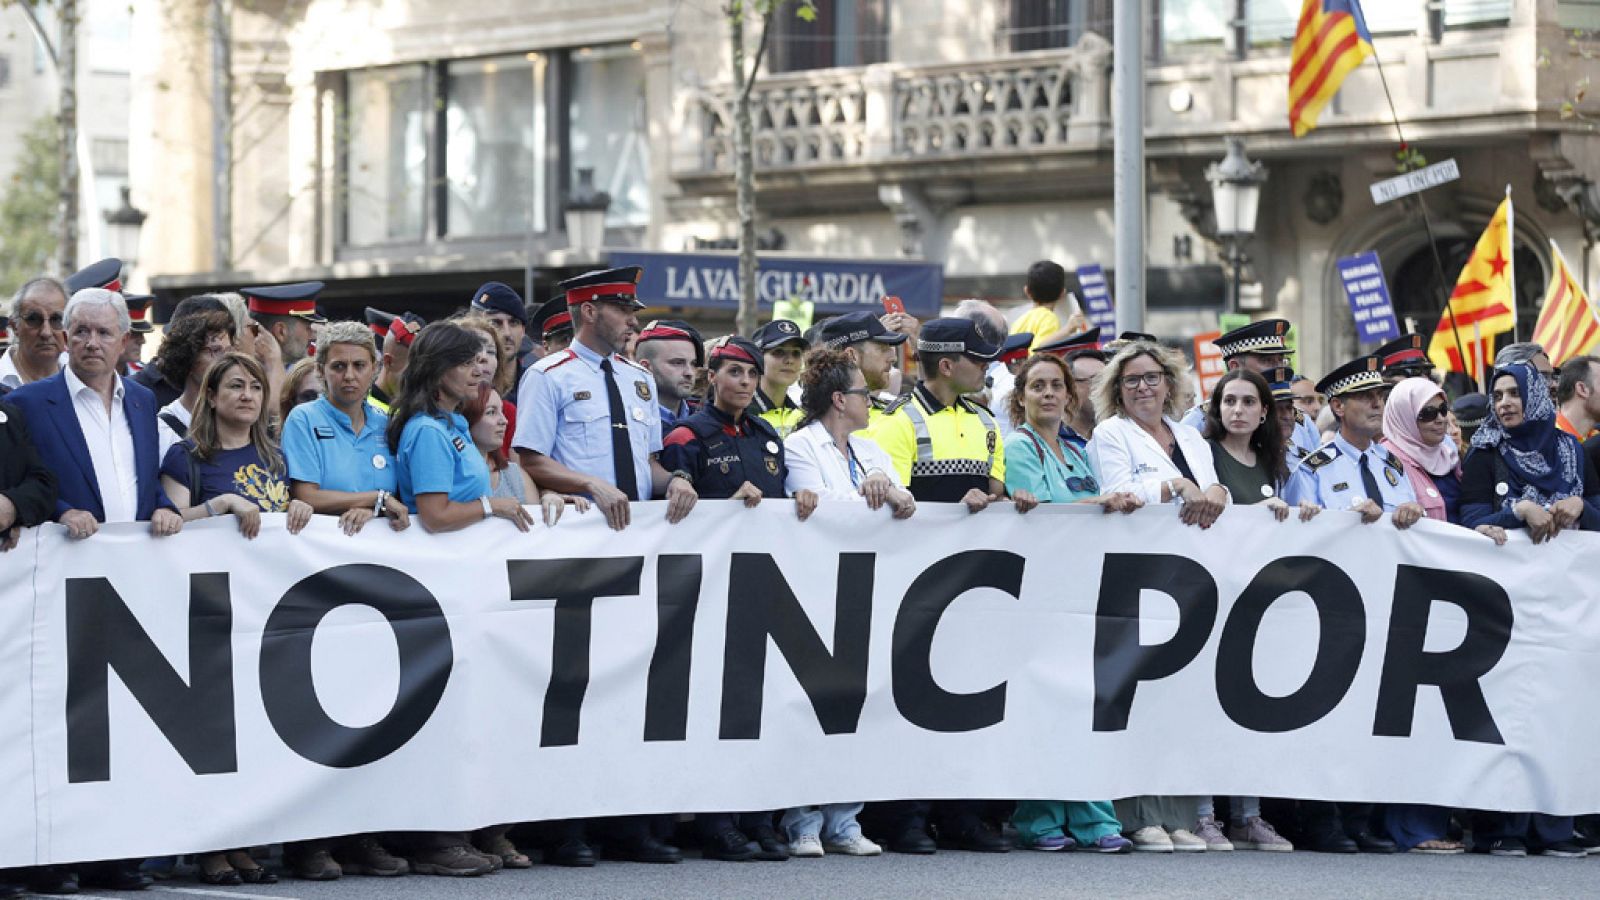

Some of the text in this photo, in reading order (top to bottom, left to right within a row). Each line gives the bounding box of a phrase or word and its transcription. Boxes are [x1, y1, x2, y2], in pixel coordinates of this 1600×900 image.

[666, 266, 702, 298] LA
[65, 549, 1515, 784] NO TINC POR
